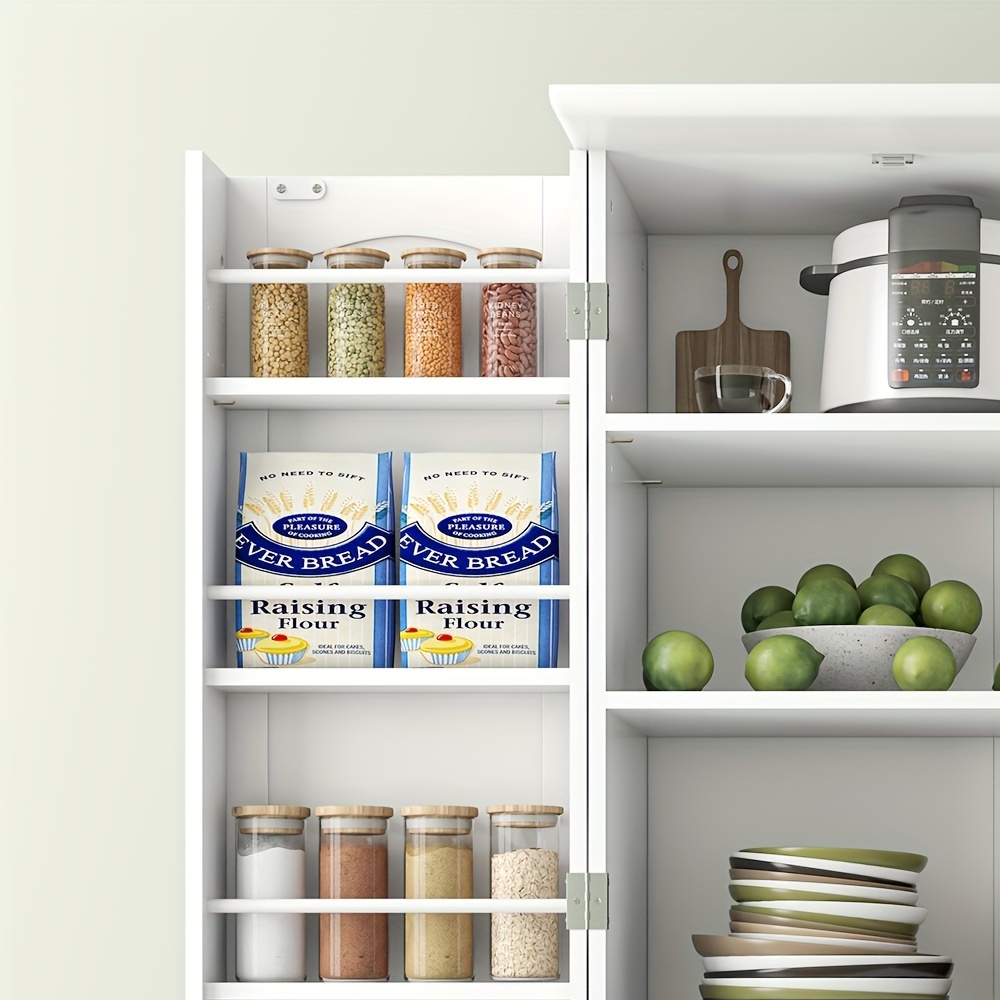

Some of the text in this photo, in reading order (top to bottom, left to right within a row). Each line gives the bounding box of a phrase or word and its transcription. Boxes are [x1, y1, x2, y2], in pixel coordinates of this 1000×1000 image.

[488, 301, 523, 309] KIDNEY
[259, 473, 277, 482] NO
[337, 472, 366, 482] SIFT
[424, 473, 440, 482] NO
[502, 472, 530, 482] SIFT
[287, 516, 303, 524] PART
[318, 516, 333, 524] THE
[453, 516, 468, 524] PART
[483, 516, 498, 524] THE
[298, 531, 332, 539] COOKING
[463, 531, 497, 539] COOKING
[235, 533, 387, 570] EVER BREAD
[400, 533, 552, 570] EVER BREAD
[250, 600, 367, 619] Raising
[415, 600, 532, 619] Raising
[278, 618, 340, 629] Flour
[443, 618, 505, 629] Flour
